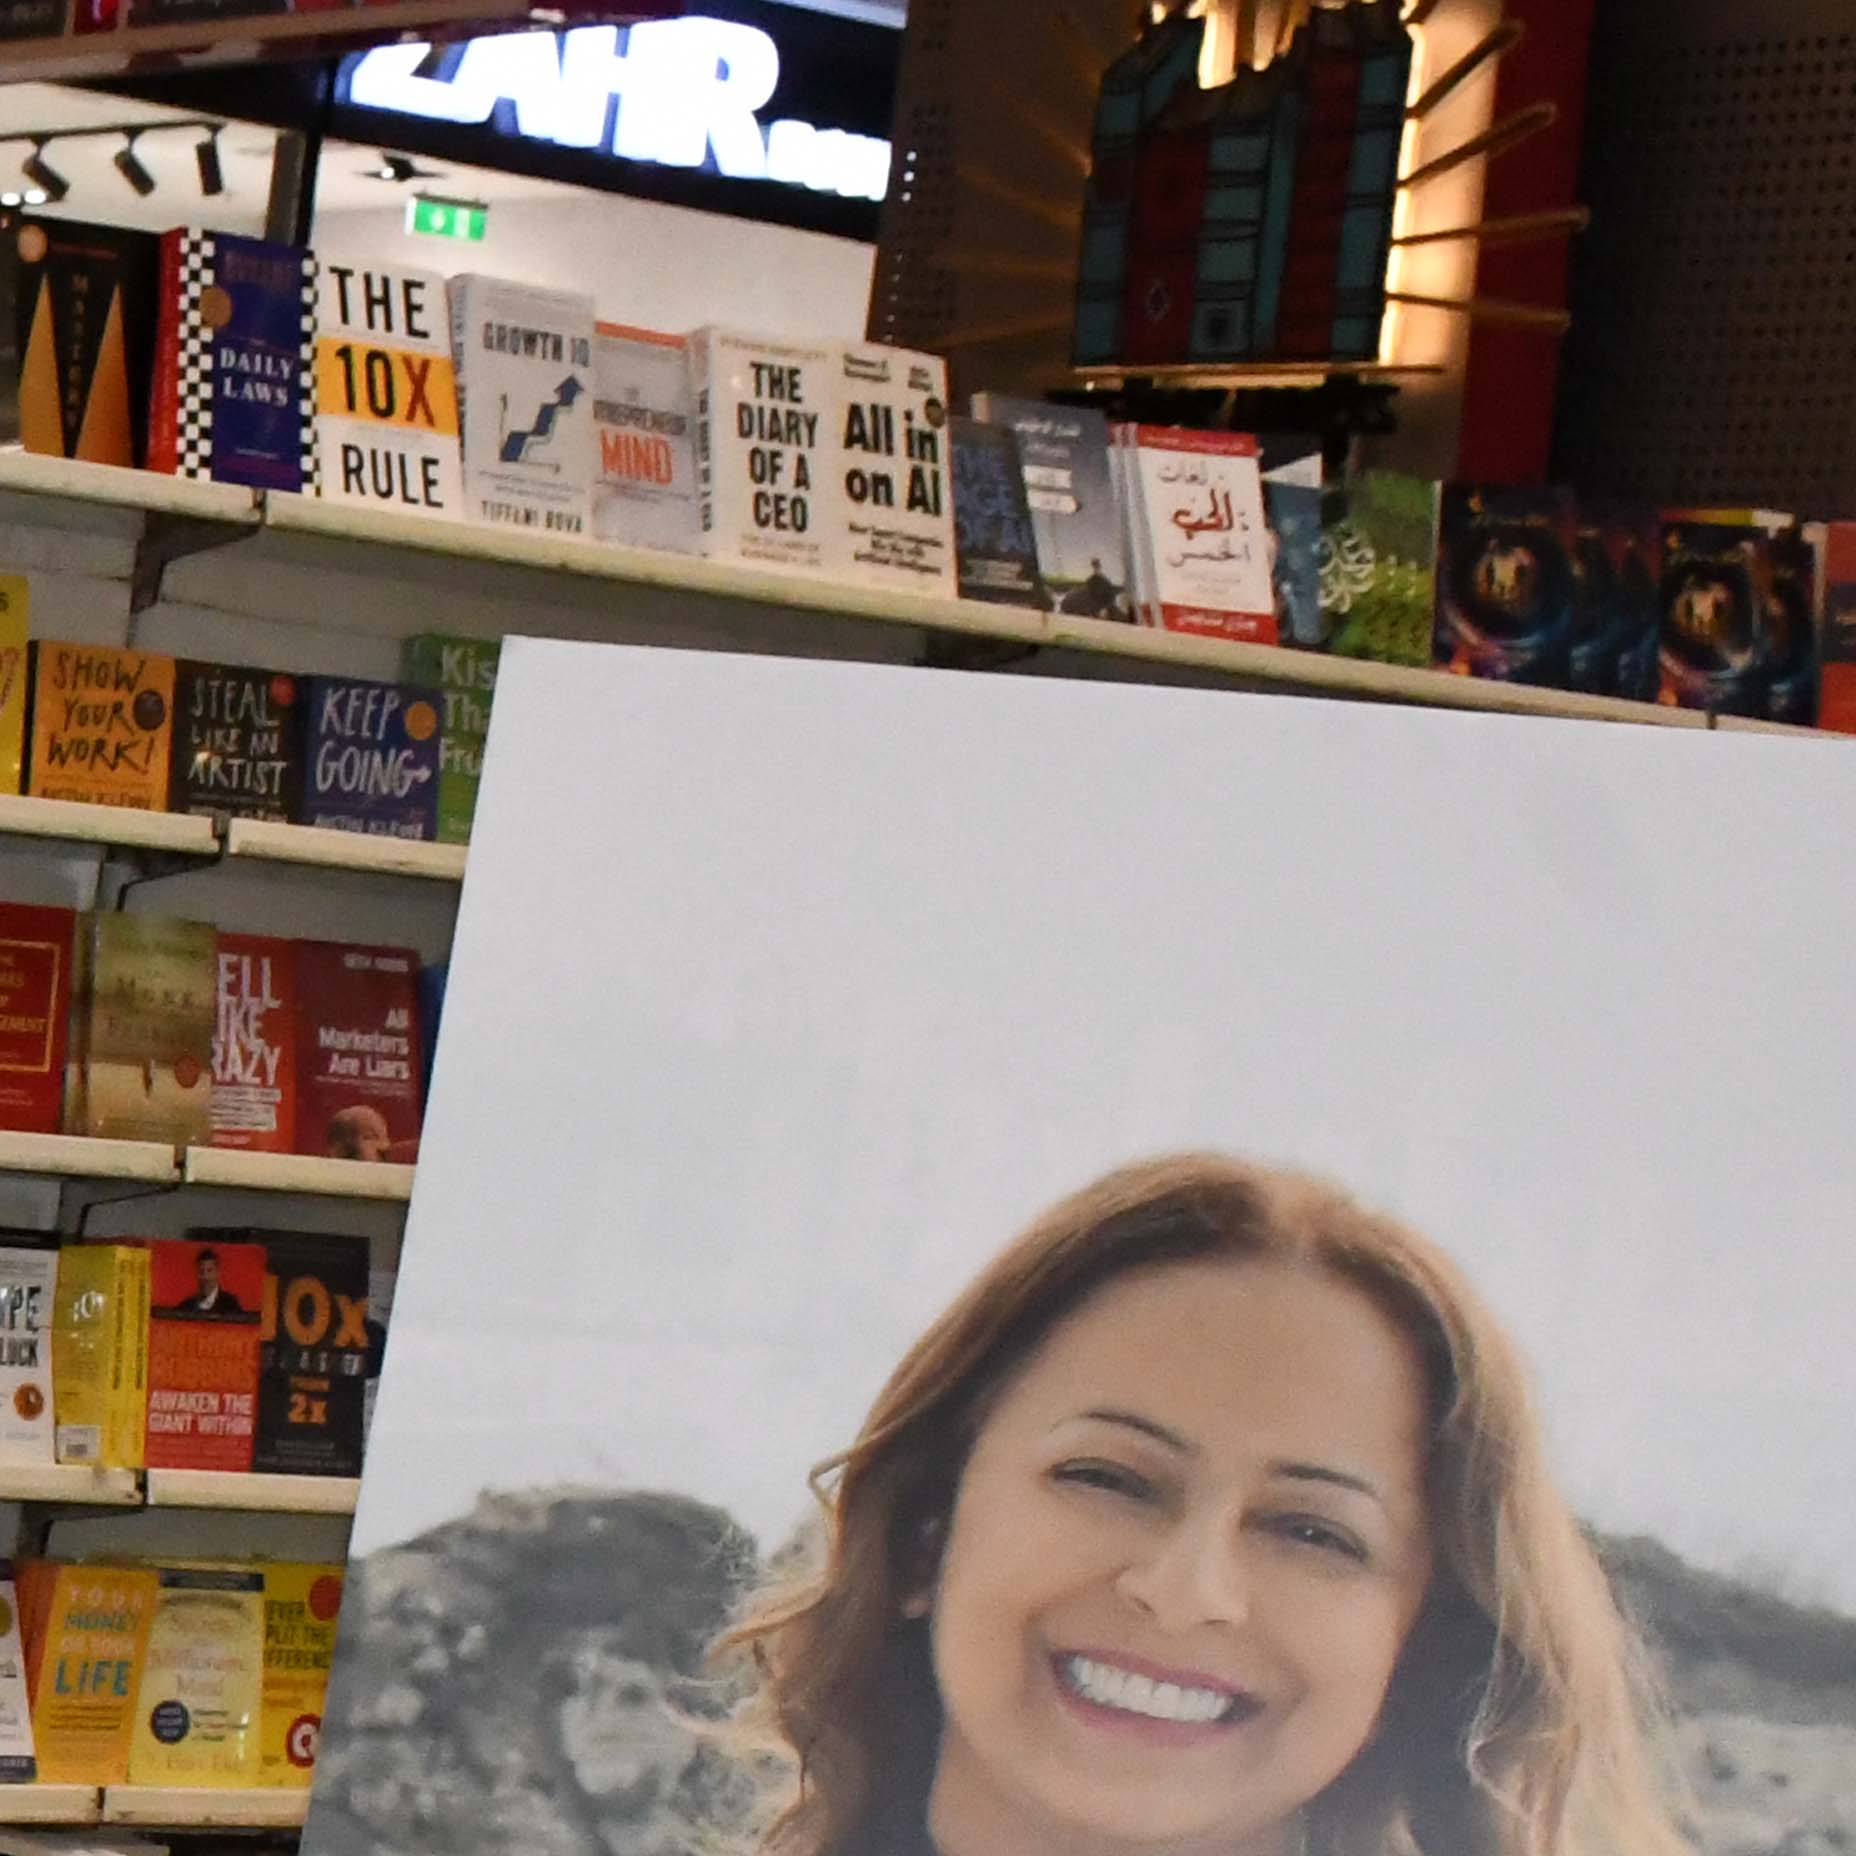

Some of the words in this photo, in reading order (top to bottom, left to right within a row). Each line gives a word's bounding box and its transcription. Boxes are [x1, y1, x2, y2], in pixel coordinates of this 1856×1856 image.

[330, 266, 430, 339] THE
[219, 346, 292, 382] DAILY
[334, 343, 436, 428] 10X
[750, 361, 803, 404] THE
[738, 402, 818, 448] DIARY
[844, 403, 895, 457] All
[905, 410, 938, 464] in
[341, 444, 443, 508] RULE
[600, 429, 674, 486] MIND
[748, 446, 783, 488] OF
[793, 457, 812, 490] A
[753, 491, 808, 533] CEO
[845, 465, 894, 507] on
[907, 465, 942, 517] AI
[53, 649, 146, 691] SHOW
[63, 698, 125, 733] YOUR
[192, 676, 274, 729] STEAL
[324, 685, 399, 739] KEEP
[315, 739, 416, 800] GOING
[149, 1389, 215, 1412] AWAKEN
[221, 1391, 252, 1412] THE
[54, 1659, 131, 1697] LIFE
